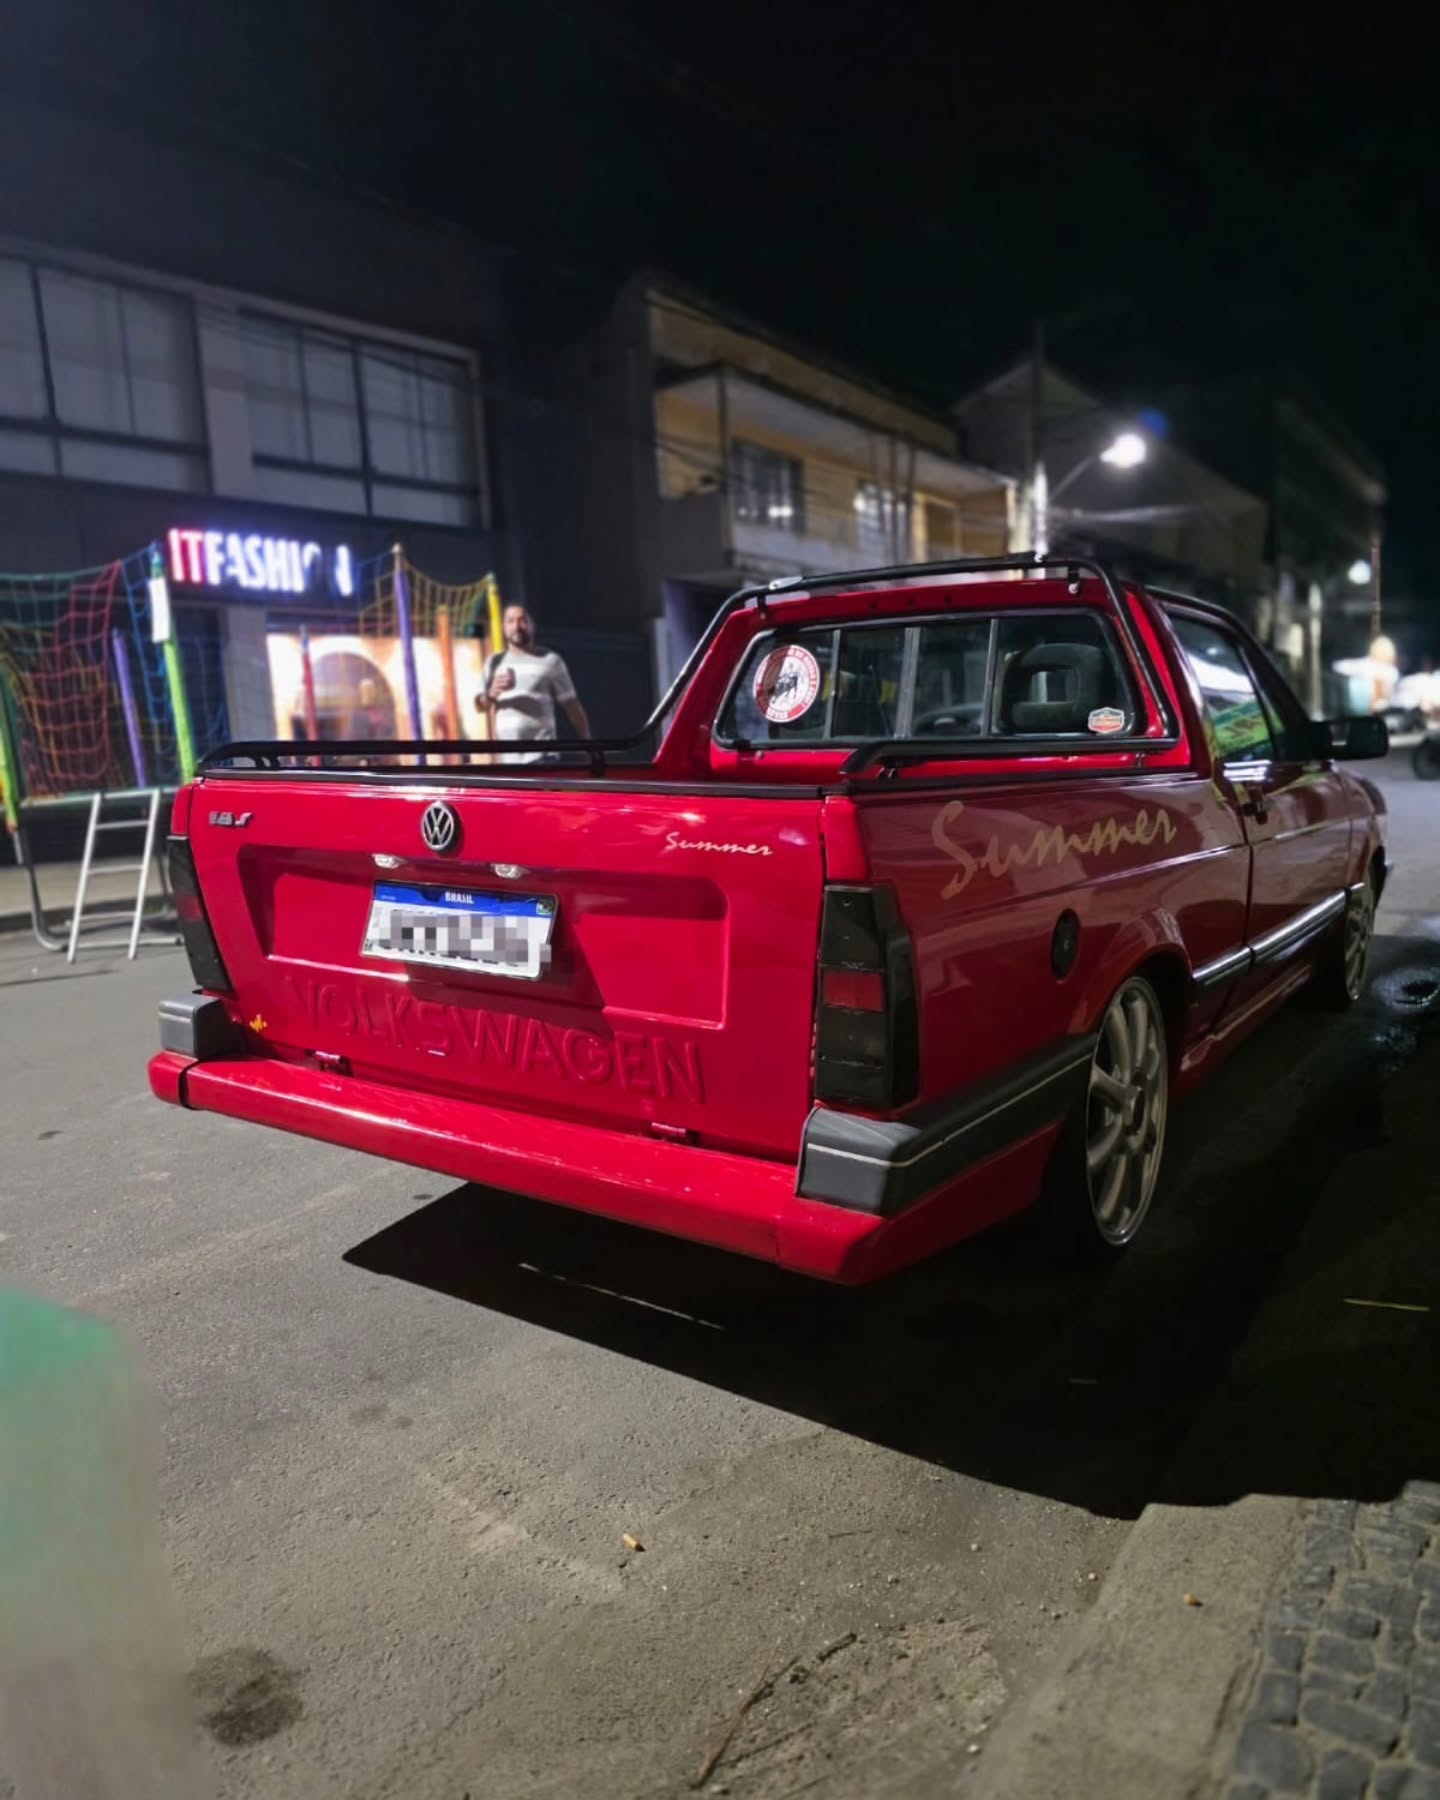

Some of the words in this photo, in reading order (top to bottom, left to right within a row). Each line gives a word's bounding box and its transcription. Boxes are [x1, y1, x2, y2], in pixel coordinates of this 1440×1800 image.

[661, 831, 773, 856] Summer
[932, 800, 1177, 900] Summer
[444, 891, 475, 905] BRASIL
[285, 975, 708, 1102] VOLKSWAGEN
